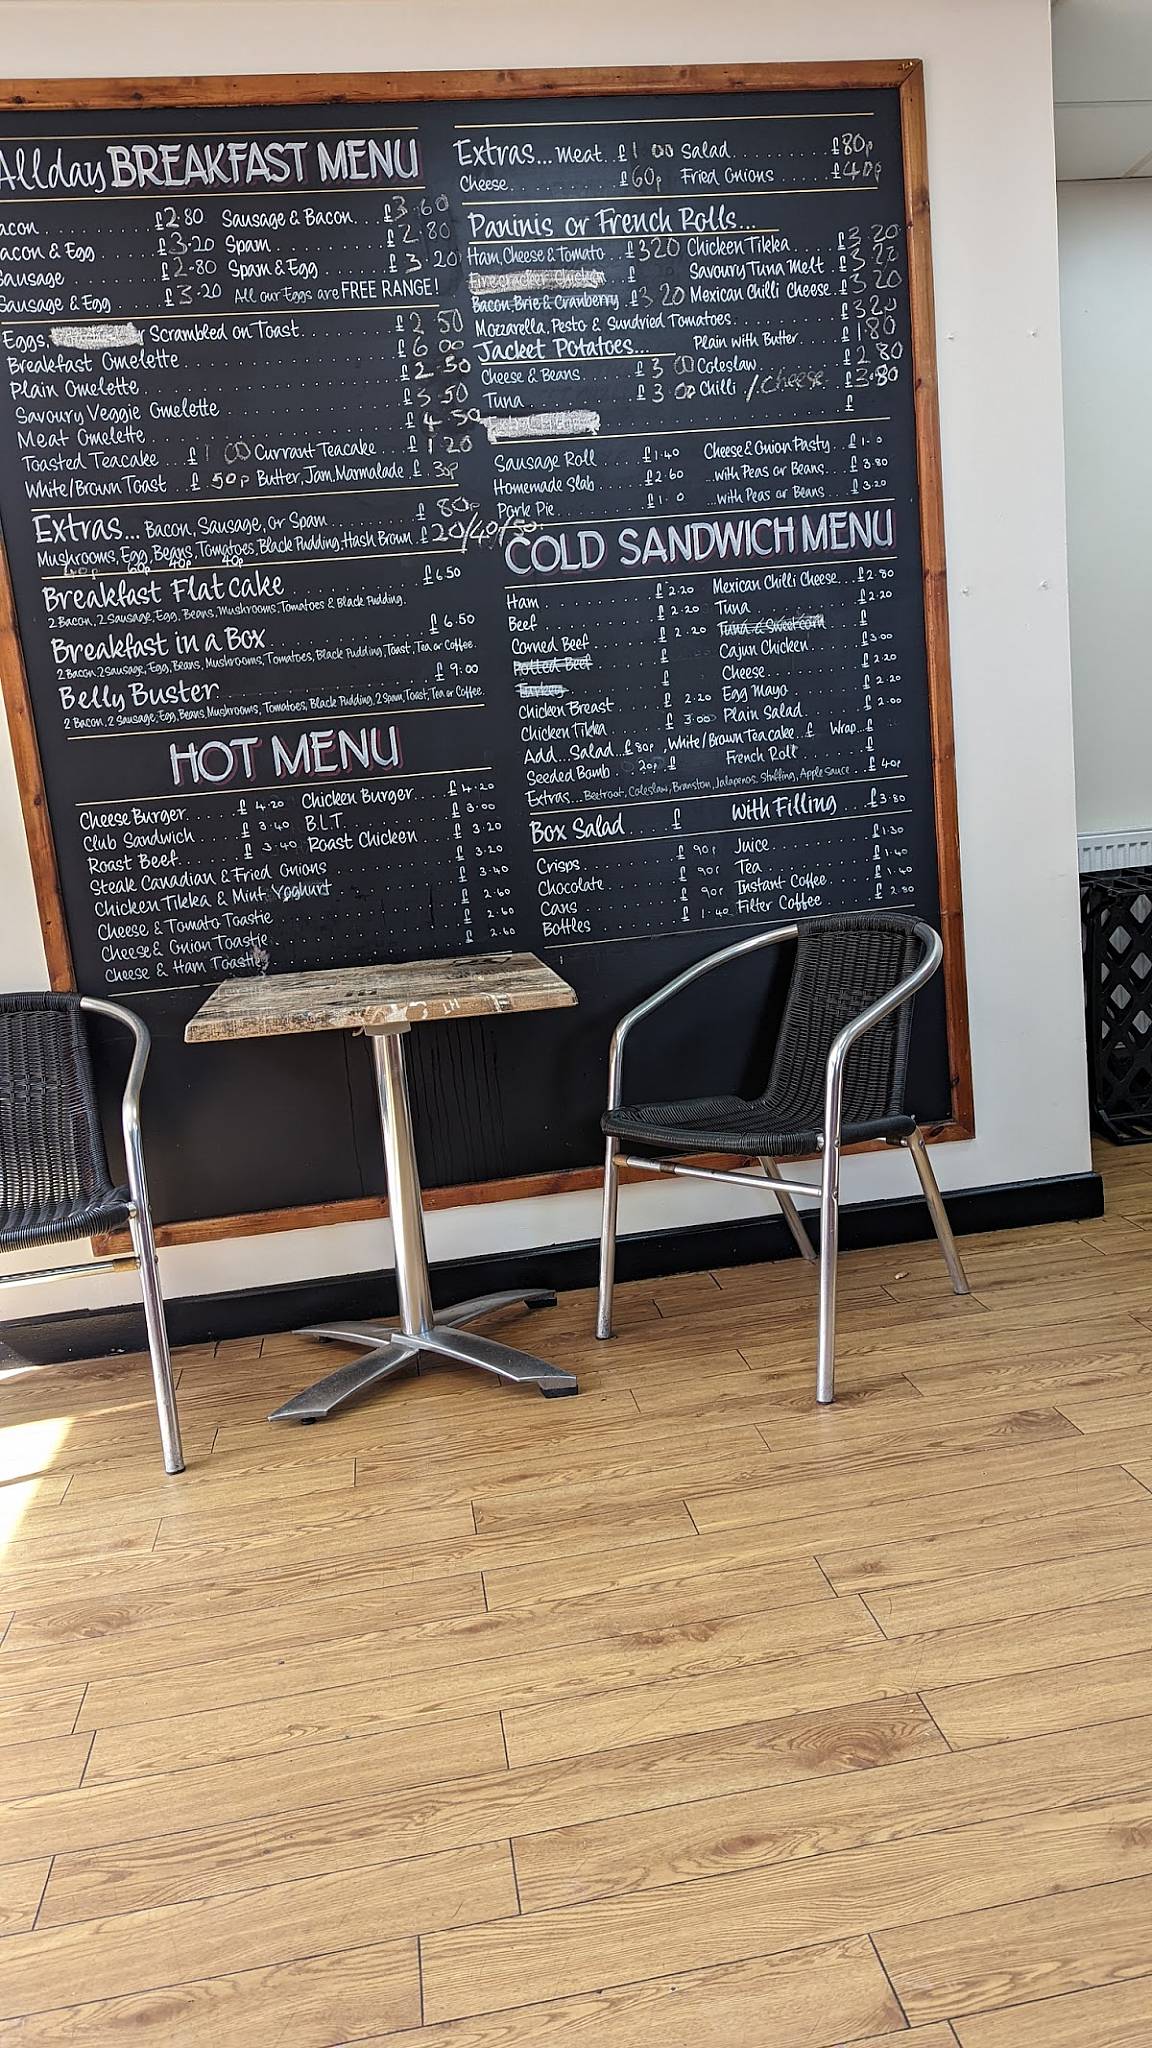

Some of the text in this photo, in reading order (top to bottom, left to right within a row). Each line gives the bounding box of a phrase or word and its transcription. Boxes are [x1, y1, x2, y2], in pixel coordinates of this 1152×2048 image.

[680, 140, 731, 160] Salad
[0, 138, 419, 194] Allday BREAKFAST MENU
[679, 167, 775, 186] Fried Onions
[459, 173, 509, 193] Cheese
[221, 207, 354, 230] Sausage Bacon
[466, 211, 554, 239] Paninis
[564, 215, 591, 237] or
[593, 206, 673, 236] French
[63, 241, 96, 263] Egg
[225, 234, 272, 256] Spam
[555, 243, 607, 263] Tomato
[686, 234, 791, 257] Chicken Tikka
[227, 258, 319, 281] Spam Egg
[689, 260, 786, 281] Savoury Tuna
[341, 277, 439, 300] FREE RANGE!
[689, 279, 780, 304] Mexican Chilli
[80, 294, 112, 314] Egg
[149, 322, 229, 343] Scrambled
[232, 325, 254, 340] on
[255, 318, 300, 339] Toast
[550, 310, 732, 334] Pesto Sundried Tomatoes
[472, 337, 547, 363] Jacket
[692, 329, 799, 351] Plain with Butter
[5, 348, 180, 376] Breakfast Omelette
[696, 354, 757, 375] Coleslaw
[9, 375, 140, 401] Plain Omelette
[480, 367, 581, 386] Cheese Beans
[699, 377, 737, 397] Chilli
[15, 397, 220, 426] Savoury Veggie Omelette
[481, 391, 525, 410] Tuna
[17, 424, 146, 450] Meat Omelette
[254, 437, 377, 461] Currant Teacake
[494, 454, 561, 473] Sausage
[563, 448, 598, 468] Roll
[20, 449, 160, 473] Toasted Teacake
[740, 460, 825, 479] Peas Beans
[24, 473, 167, 499] White/Brown Toast
[493, 476, 564, 496] Homemade
[566, 474, 595, 493] Slab
[744, 484, 825, 504] Peas Beans
[534, 500, 555, 517] Pie
[288, 511, 329, 531] Spam
[504, 508, 893, 573] COLD SANDWICH MENU
[41, 579, 162, 613] Breakfast
[169, 572, 226, 603] Flat
[712, 577, 762, 595] Mexican
[763, 571, 797, 590] Chilli
[799, 570, 838, 587] Cheese
[506, 593, 540, 611] Ham
[713, 599, 752, 616] Tuna
[508, 613, 538, 632] Beef
[50, 626, 266, 665] Breakfast in a Box
[314, 647, 344, 661] Black
[560, 632, 590, 653] Beef
[719, 642, 759, 662] Cajun
[760, 636, 809, 656] Chicken
[721, 664, 766, 681] Cheese
[58, 679, 220, 713] Belly Buster
[721, 685, 749, 703] Egg
[518, 696, 615, 720] Chicken Breast
[723, 701, 804, 723] Plain Salad
[520, 724, 571, 742] Chicken
[169, 725, 399, 786] HOT MENU
[725, 746, 766, 765] French
[526, 768, 576, 787] Seeded
[301, 787, 415, 810] Chicken Burger
[771, 791, 837, 818] Filling
[79, 807, 187, 831] Cheese Burger
[528, 811, 626, 845] Box Salad
[83, 826, 196, 853] Club Sandwich
[306, 828, 418, 853] Roast Chicken
[734, 837, 770, 854] Juice
[86, 848, 179, 875] Roast Beef
[536, 857, 581, 875] Crisps
[734, 858, 763, 875] Tea
[89, 861, 327, 896] Steak Canadian Fried Onions
[537, 876, 605, 897] Chocolate
[790, 871, 828, 890] Coffee
[94, 878, 333, 918] Chicken Tikka Mint Yoghurt
[735, 892, 823, 914] Filter Coffee
[97, 909, 274, 941] Cheese Tomato Toastie
[542, 916, 591, 937] Bottles
[101, 939, 213, 963] Cheese Onion
[104, 958, 207, 983] Cheese Ham
